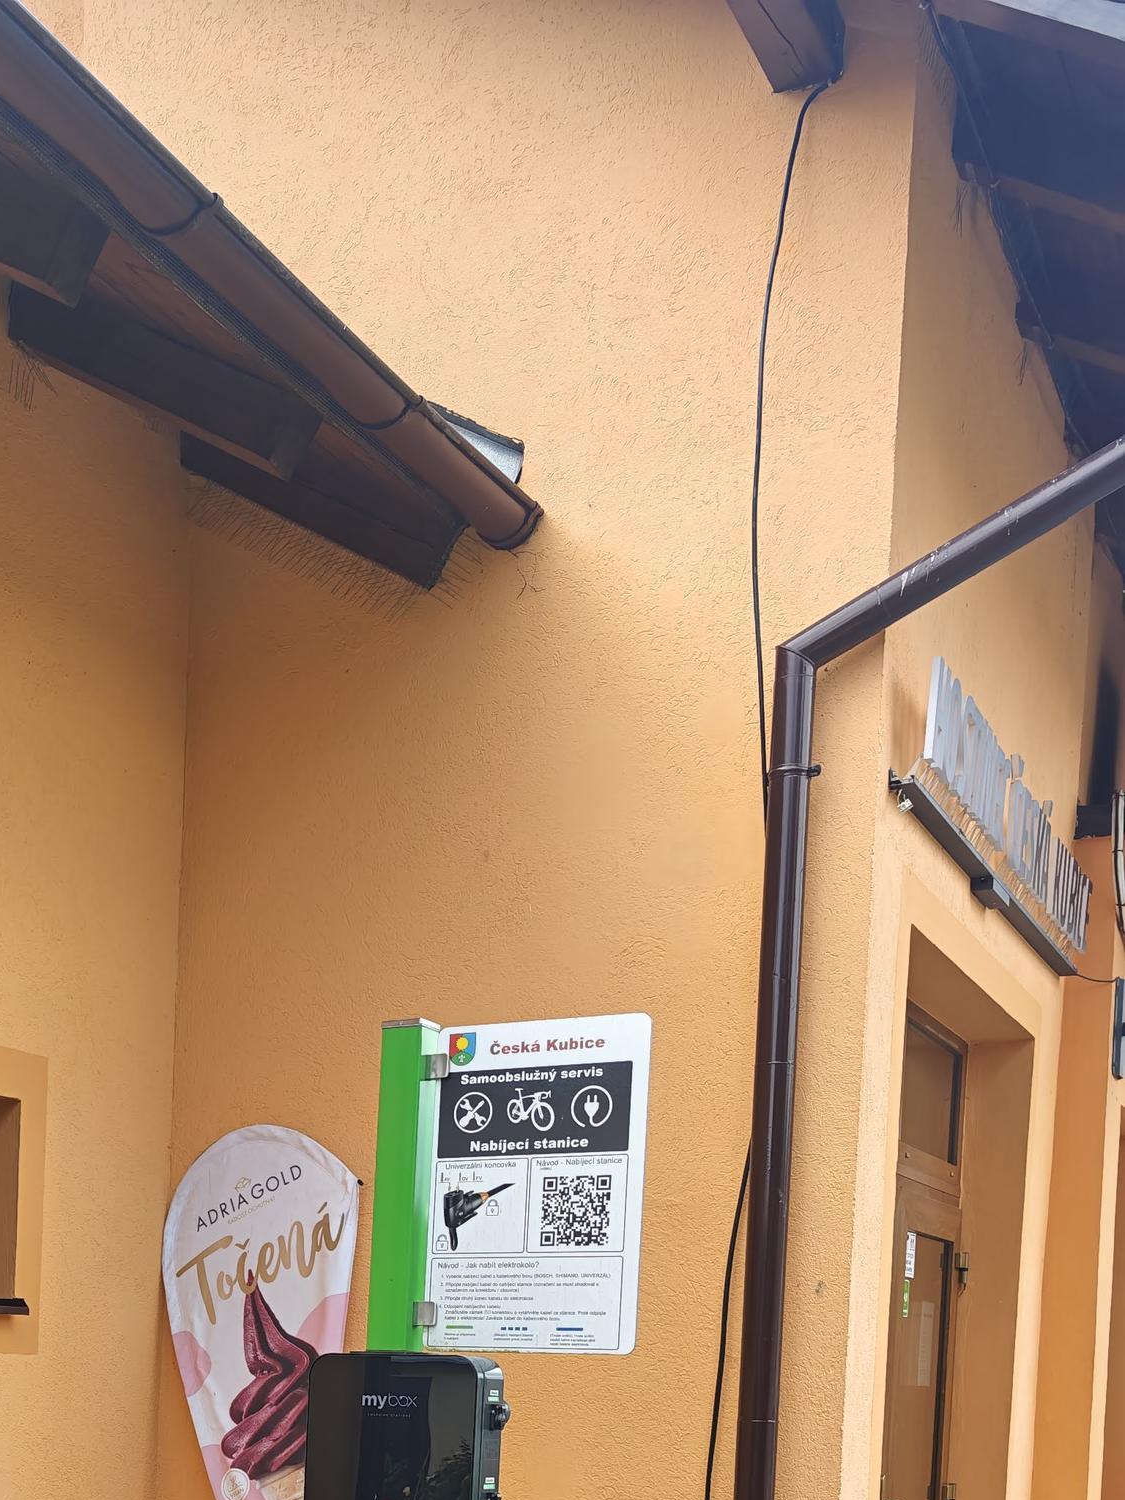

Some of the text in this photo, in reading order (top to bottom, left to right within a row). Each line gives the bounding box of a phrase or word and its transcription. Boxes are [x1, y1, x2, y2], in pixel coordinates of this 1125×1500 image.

[1046, 836, 1093, 954] KUBICE
[490, 1036, 605, 1055] Česká Kubice
[460, 1066, 604, 1085] Samoobslužný servis
[470, 1136, 589, 1153] Nabíjecí stanice
[484, 1160, 517, 1168] koncovka
[596, 1156, 623, 1164] stanice
[196, 1165, 302, 1232] ADRIA GOLD
[176, 1202, 345, 1325] Točená
[464, 1261, 477, 1269] Jak
[497, 1260, 540, 1269] elektrokolo?
[362, 1392, 418, 1410] mybox
